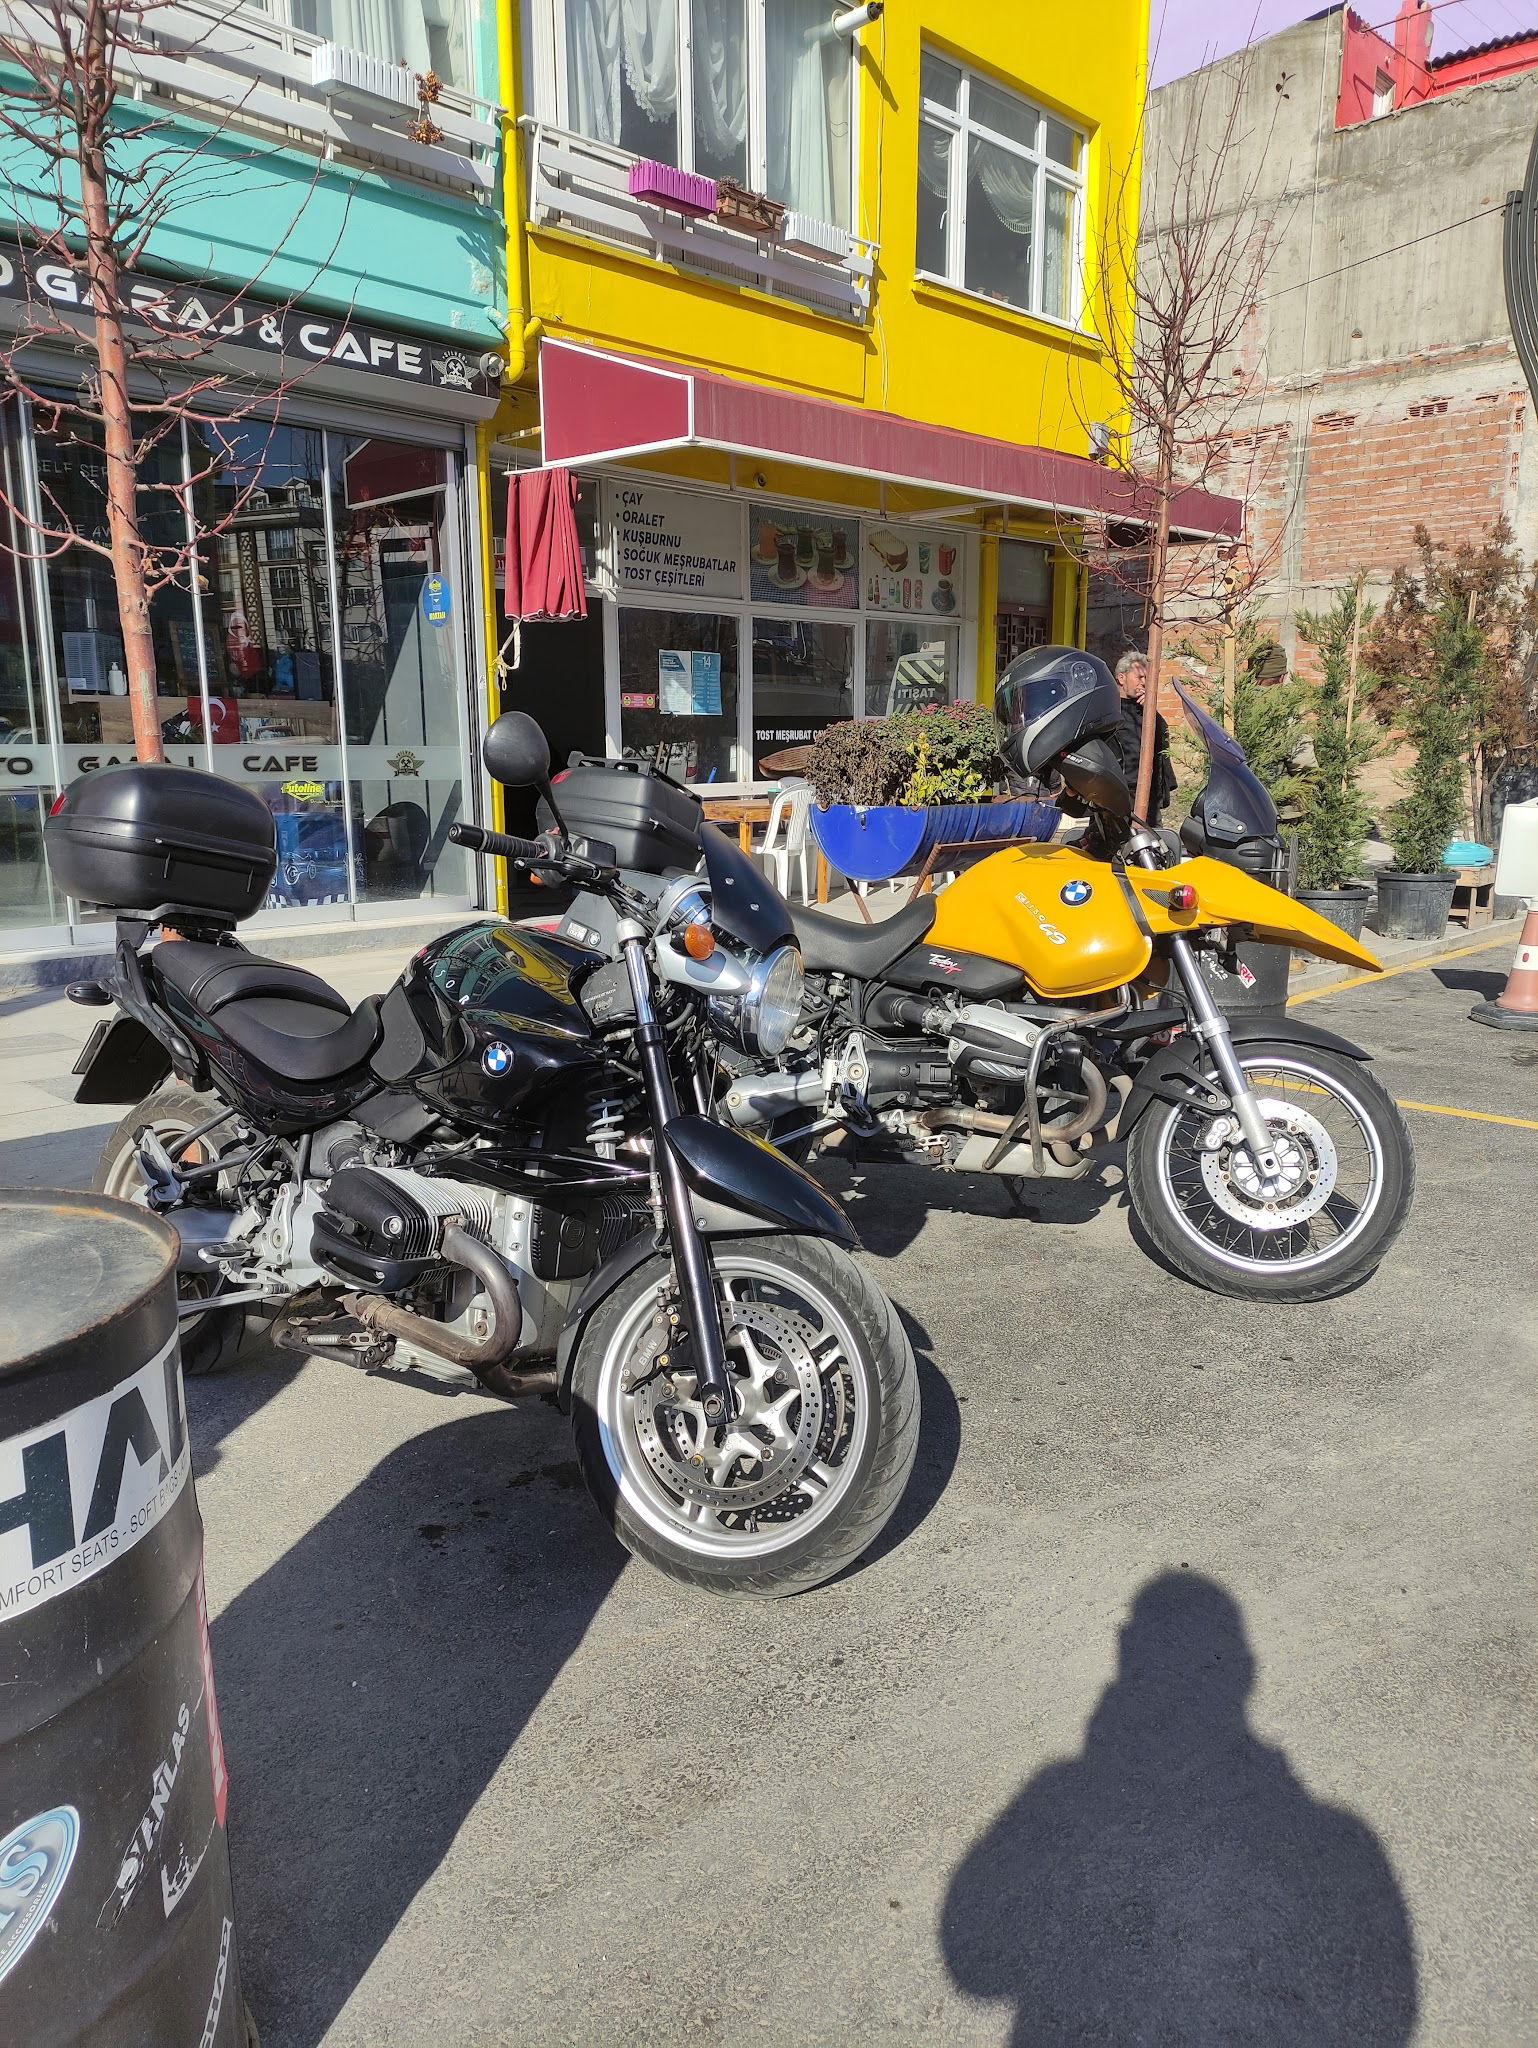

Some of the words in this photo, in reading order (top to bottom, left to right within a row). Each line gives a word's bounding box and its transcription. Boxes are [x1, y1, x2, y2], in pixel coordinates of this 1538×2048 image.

[36, 264, 245, 336] GRAJ
[300, 323, 424, 376] CAFE
[622, 491, 644, 507] ÇAY
[622, 510, 665, 528] ORALET
[623, 529, 682, 548] KUŞBURNU
[623, 546, 661, 564] SOĞUK
[663, 552, 737, 573] MEŞRUBATLAR
[624, 566, 652, 581] TOST
[654, 568, 705, 588] ÇEŞİTLERİ
[755, 729, 775, 741] TOST
[775, 729, 812, 743] MEŞRUBAT
[0, 756, 34, 775] O
[242, 754, 318, 773] CAFE
[638, 1339, 658, 1366] BMW
[71, 1530, 120, 1574] SEATS
[130, 1495, 158, 1534] SOFT
[6, 1881, 49, 1950] ACCESSORIES
